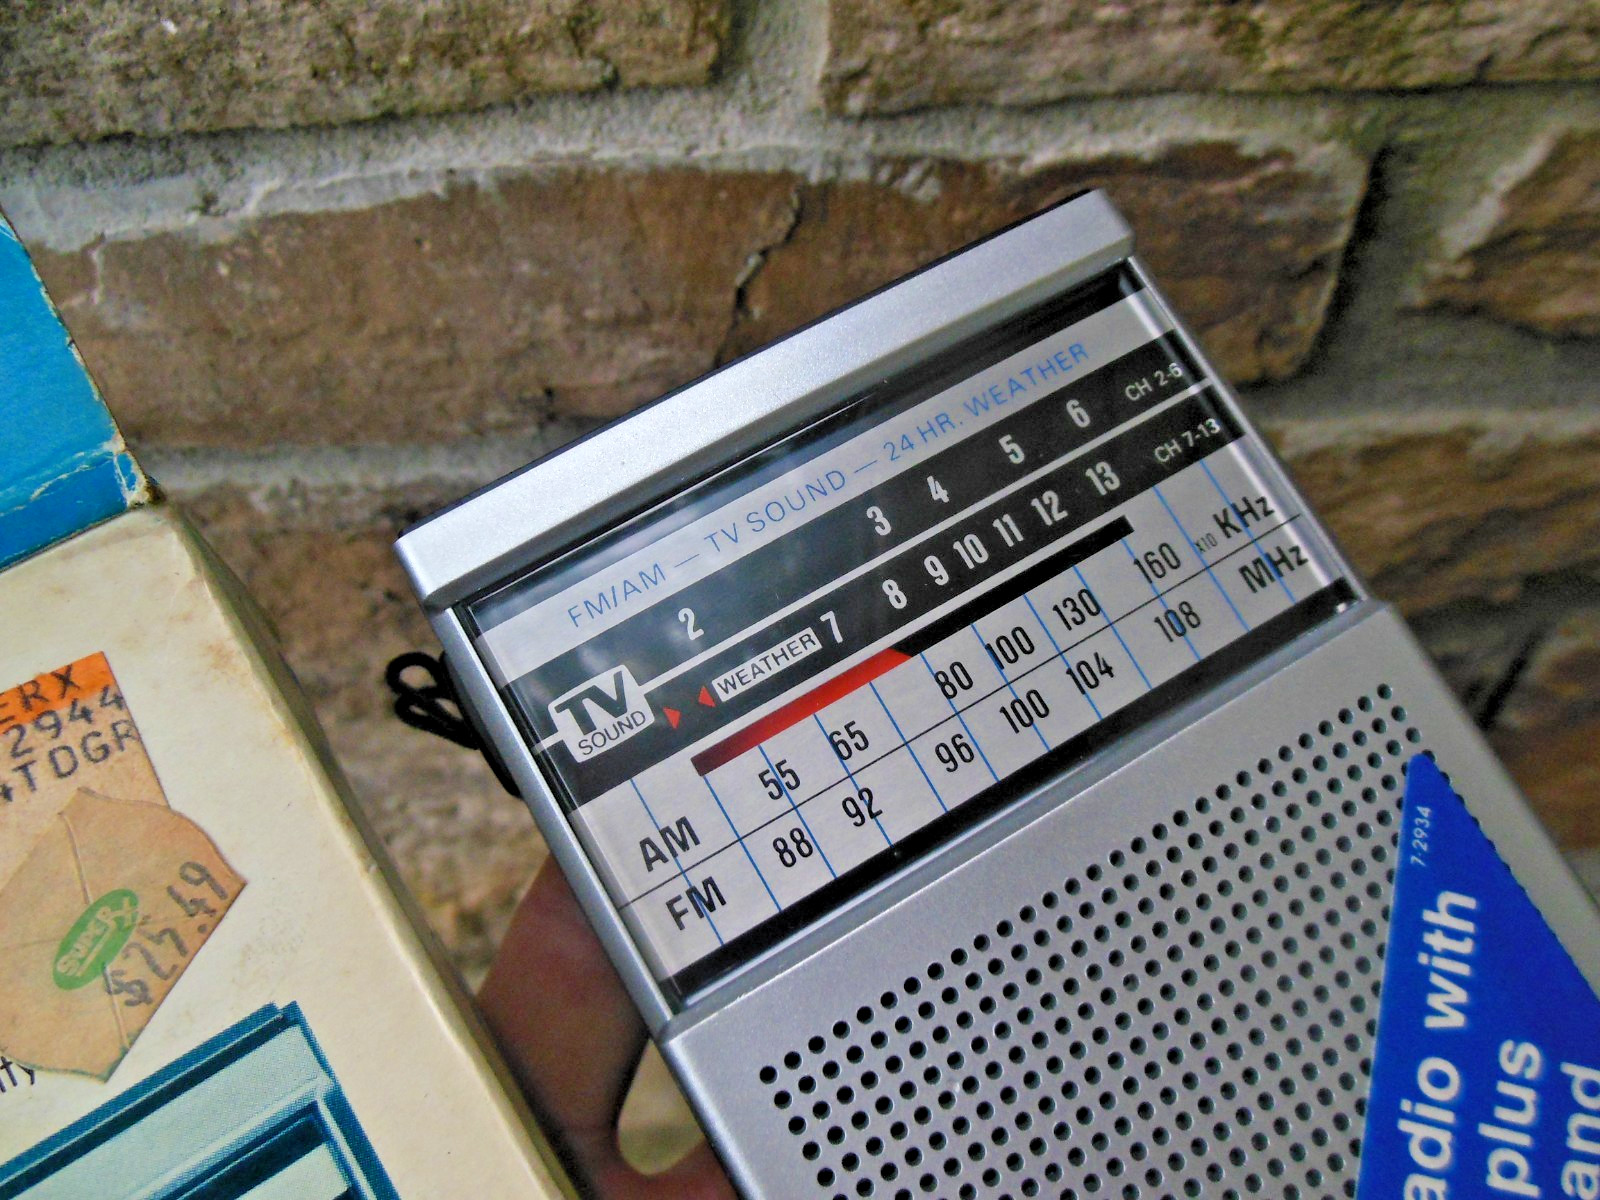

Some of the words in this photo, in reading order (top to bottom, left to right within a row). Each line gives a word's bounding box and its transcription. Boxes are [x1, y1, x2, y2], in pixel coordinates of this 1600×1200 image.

[567, 563, 666, 627] FM/AM
[703, 522, 739, 552] TV
[746, 470, 846, 532] SOUND
[883, 433, 915, 462] 24
[916, 412, 964, 444] HR.
[963, 342, 1089, 418] WEATHER
[678, 607, 705, 641] 2
[866, 506, 892, 536] 3
[926, 475, 950, 503] 4
[998, 434, 1025, 464] 5
[1065, 399, 1091, 428] 6
[1124, 378, 1153, 402] CH
[1154, 362, 1183, 387] 2-6
[717, 633, 817, 695] WEATHER
[820, 610, 844, 644] 7
[882, 579, 908, 609] 8
[923, 555, 949, 586] 9
[952, 533, 990, 570] 10
[992, 513, 1024, 547] 11
[1030, 490, 1069, 526] 12
[1085, 461, 1121, 496] 13
[1154, 439, 1183, 463] CH
[1182, 418, 1221, 447] 7-13
[2, 684, 124, 759] 2944
[554, 670, 629, 736] TV
[577, 710, 647, 756] SOUND
[638, 815, 701, 873] AM
[758, 759, 801, 800] 55
[829, 720, 869, 761] 65
[934, 661, 974, 700] 80
[985, 626, 1035, 670] 100
[1052, 588, 1101, 631] 130
[1133, 542, 1182, 585] 160
[1213, 496, 1275, 539] KHz
[665, 876, 727, 931] FM
[772, 827, 814, 868] 88
[841, 787, 883, 827] 92
[935, 733, 975, 773] 96
[999, 689, 1050, 734] 100
[1066, 651, 1115, 695] 104
[1153, 600, 1201, 643] 108
[1238, 545, 1309, 594] MHz
[1417, 890, 1478, 1029] with
[1398, 1057, 1461, 1200] adio
[1478, 1039, 1542, 1198] plus
